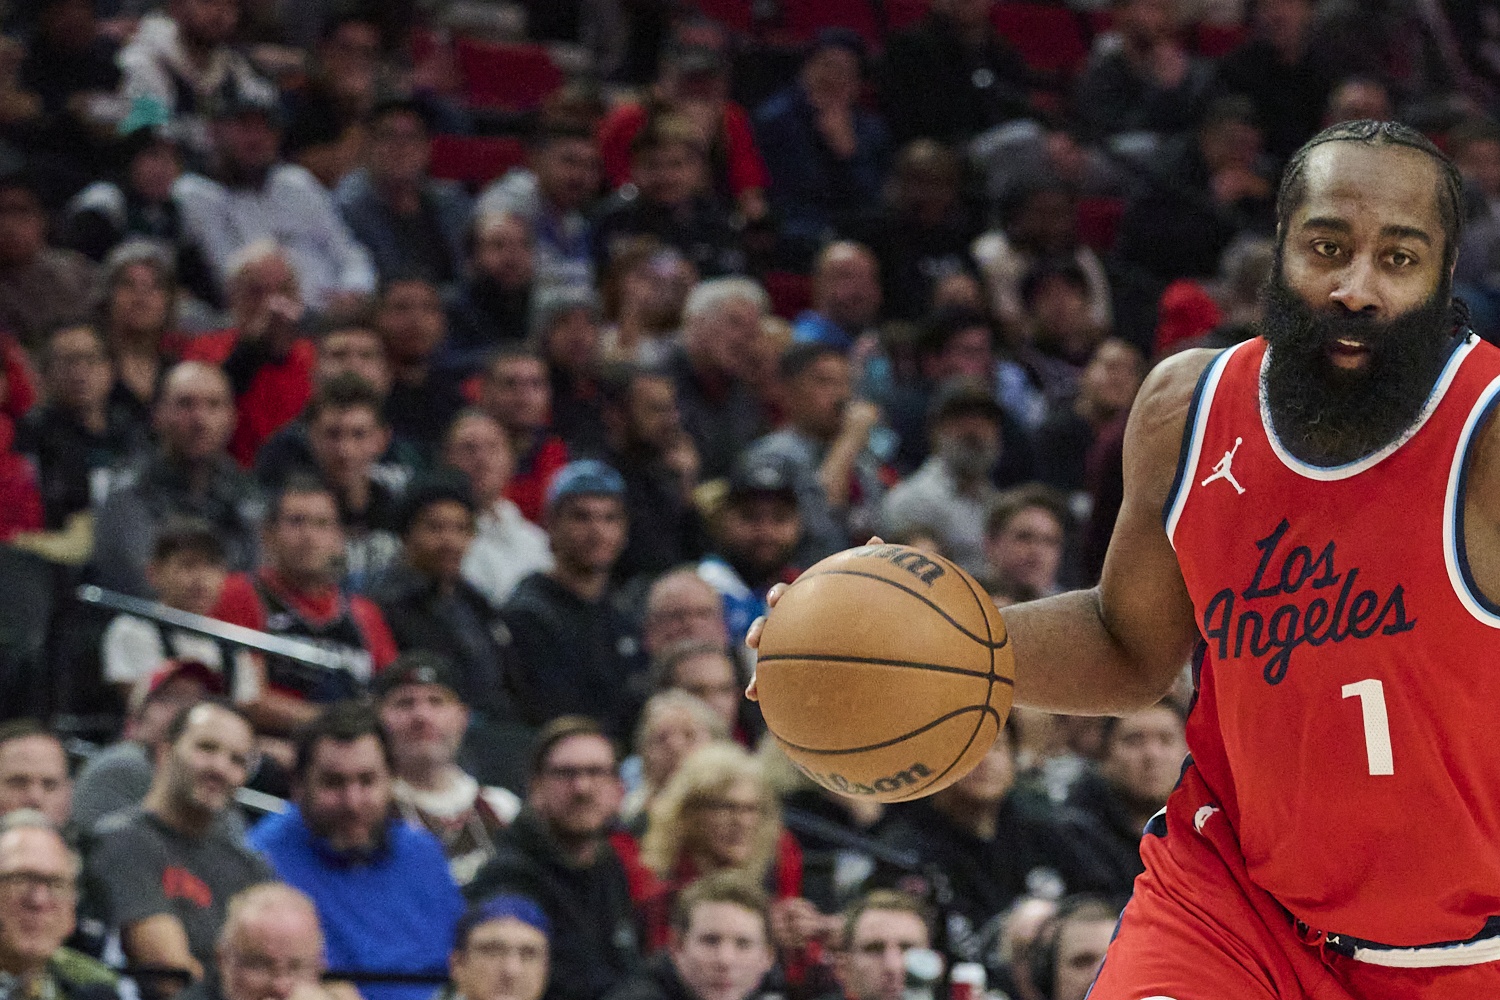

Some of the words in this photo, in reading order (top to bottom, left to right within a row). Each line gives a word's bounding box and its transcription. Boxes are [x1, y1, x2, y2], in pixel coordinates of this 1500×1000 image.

[1242, 518, 1341, 600] Los
[1203, 568, 1418, 686] Angeles
[1341, 678, 1395, 776] 1
